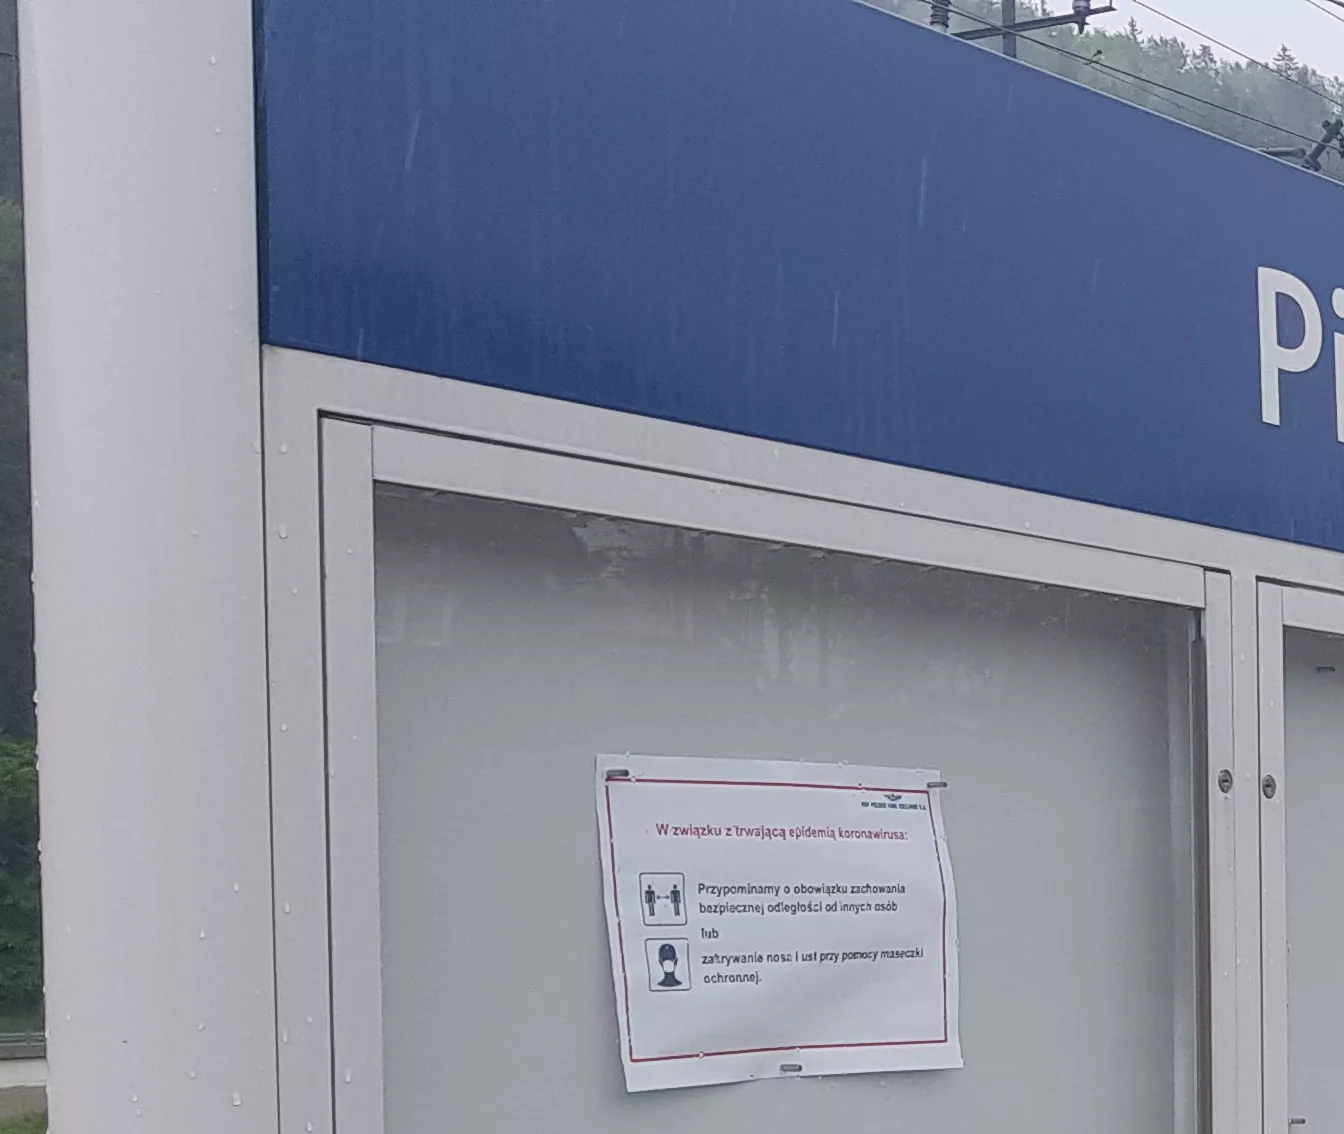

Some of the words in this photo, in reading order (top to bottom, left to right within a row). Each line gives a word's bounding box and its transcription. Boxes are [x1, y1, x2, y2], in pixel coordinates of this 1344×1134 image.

[656, 823, 669, 836] W
[671, 824, 722, 840] związku
[725, 828, 732, 837] z
[734, 825, 787, 840] trwającą
[789, 825, 836, 841] epidemią
[698, 883, 781, 898] Przypominamy
[783, 886, 791, 894] o
[793, 883, 848, 897] obowiązku
[850, 883, 906, 894] zachowania
[699, 902, 765, 916] bezpiecznej
[767, 901, 823, 916] odległości
[825, 901, 838, 912] od
[840, 901, 872, 915] innych
[874, 901, 898, 912] osób
[701, 927, 719, 939] lub
[819, 952, 840, 964] przy
[841, 950, 879, 963] pomocy
